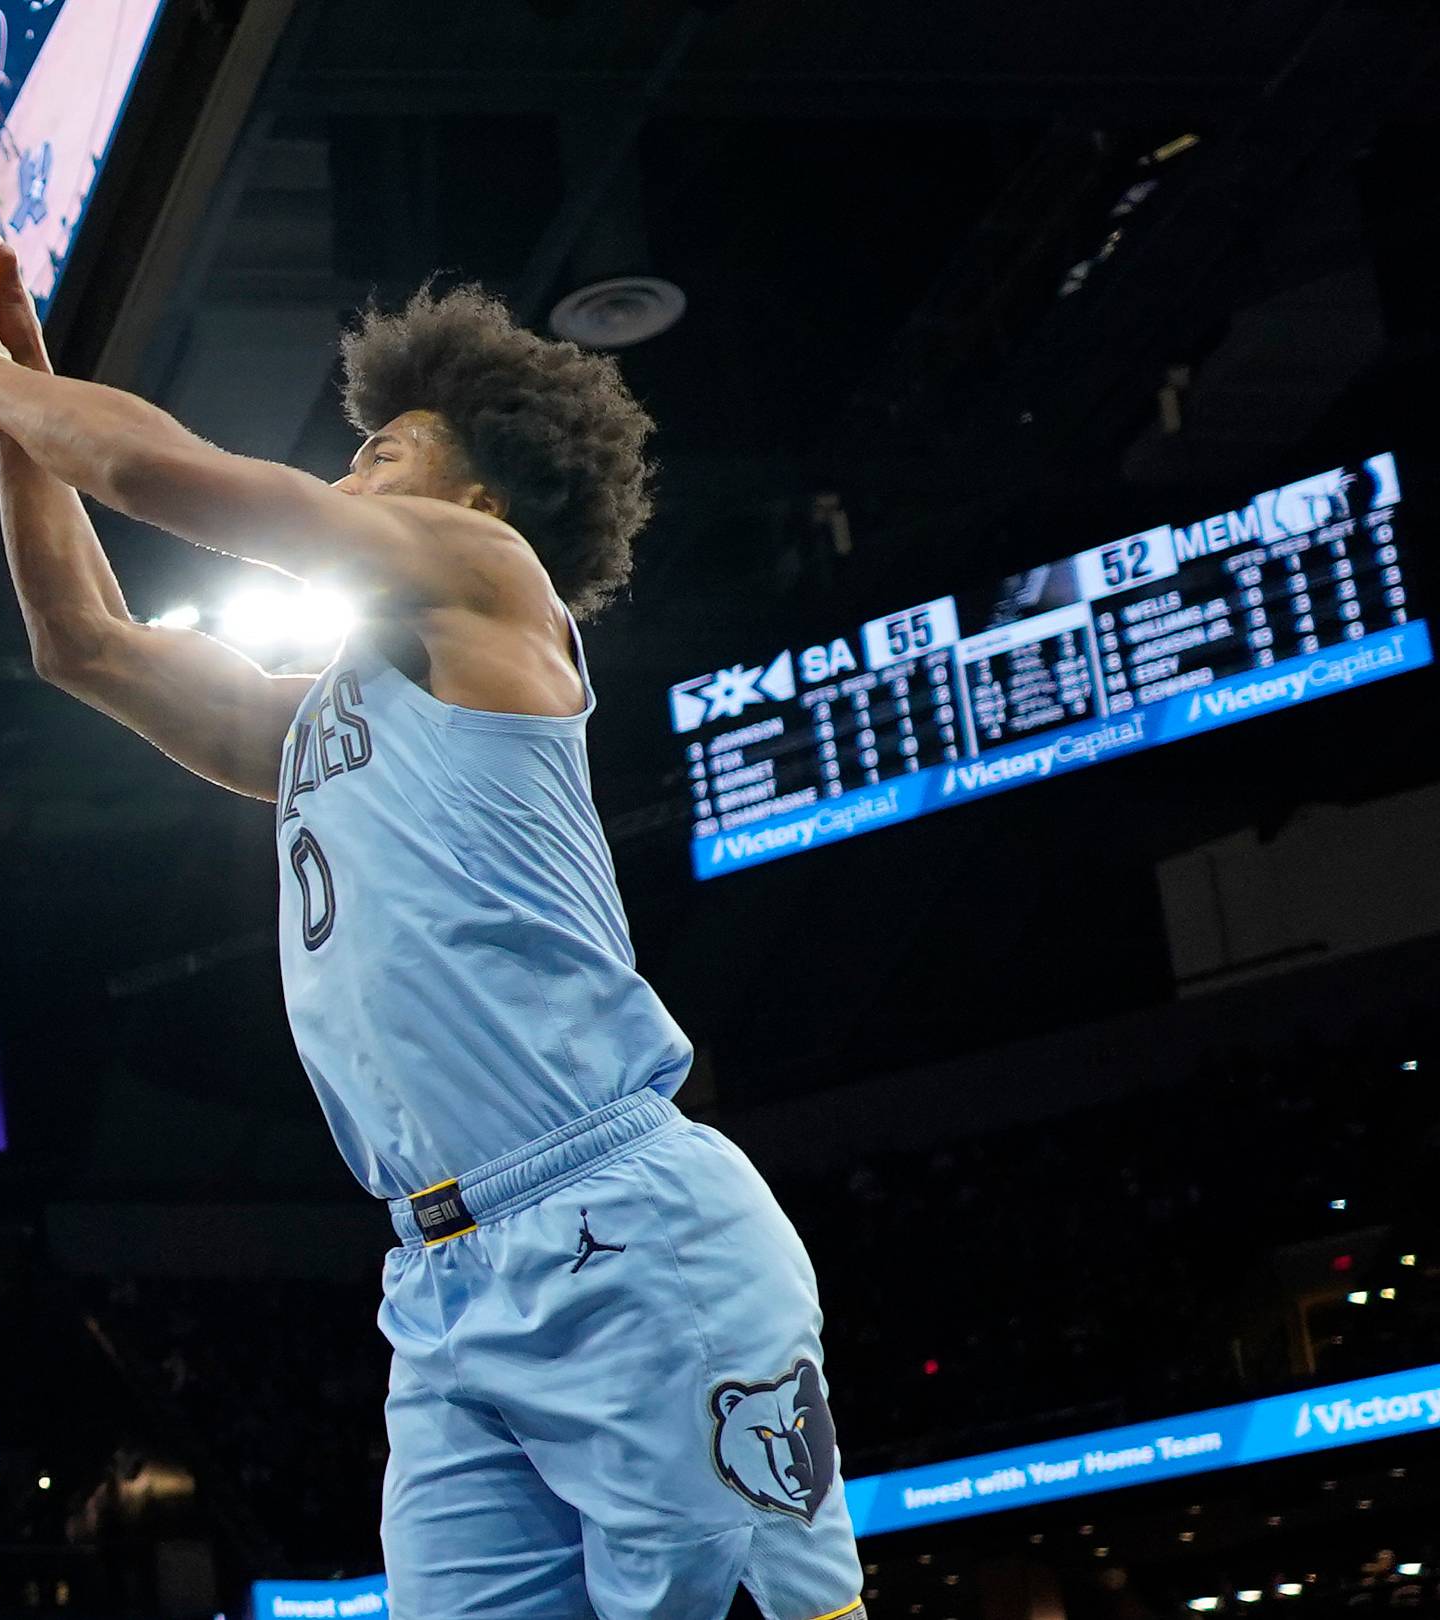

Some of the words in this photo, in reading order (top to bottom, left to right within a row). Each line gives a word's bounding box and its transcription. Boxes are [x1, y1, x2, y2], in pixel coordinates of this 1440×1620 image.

[1101, 540, 1154, 587] 52
[1174, 504, 1259, 564] MEM
[1123, 591, 1181, 623] WELLS
[800, 638, 856, 683] SA
[887, 612, 934, 656] 55
[1205, 636, 1405, 709] VictoryCapital
[957, 713, 1145, 790] VictoryCapital
[728, 789, 899, 861] VictoryCapital
[290, 826, 336, 952] 0
[904, 1477, 973, 1510] Invest
[975, 1467, 1027, 1495] with
[1028, 1460, 1080, 1485] Your
[1083, 1445, 1155, 1474] Home
[1156, 1432, 1222, 1460] Team
[273, 1595, 336, 1618] Invest
